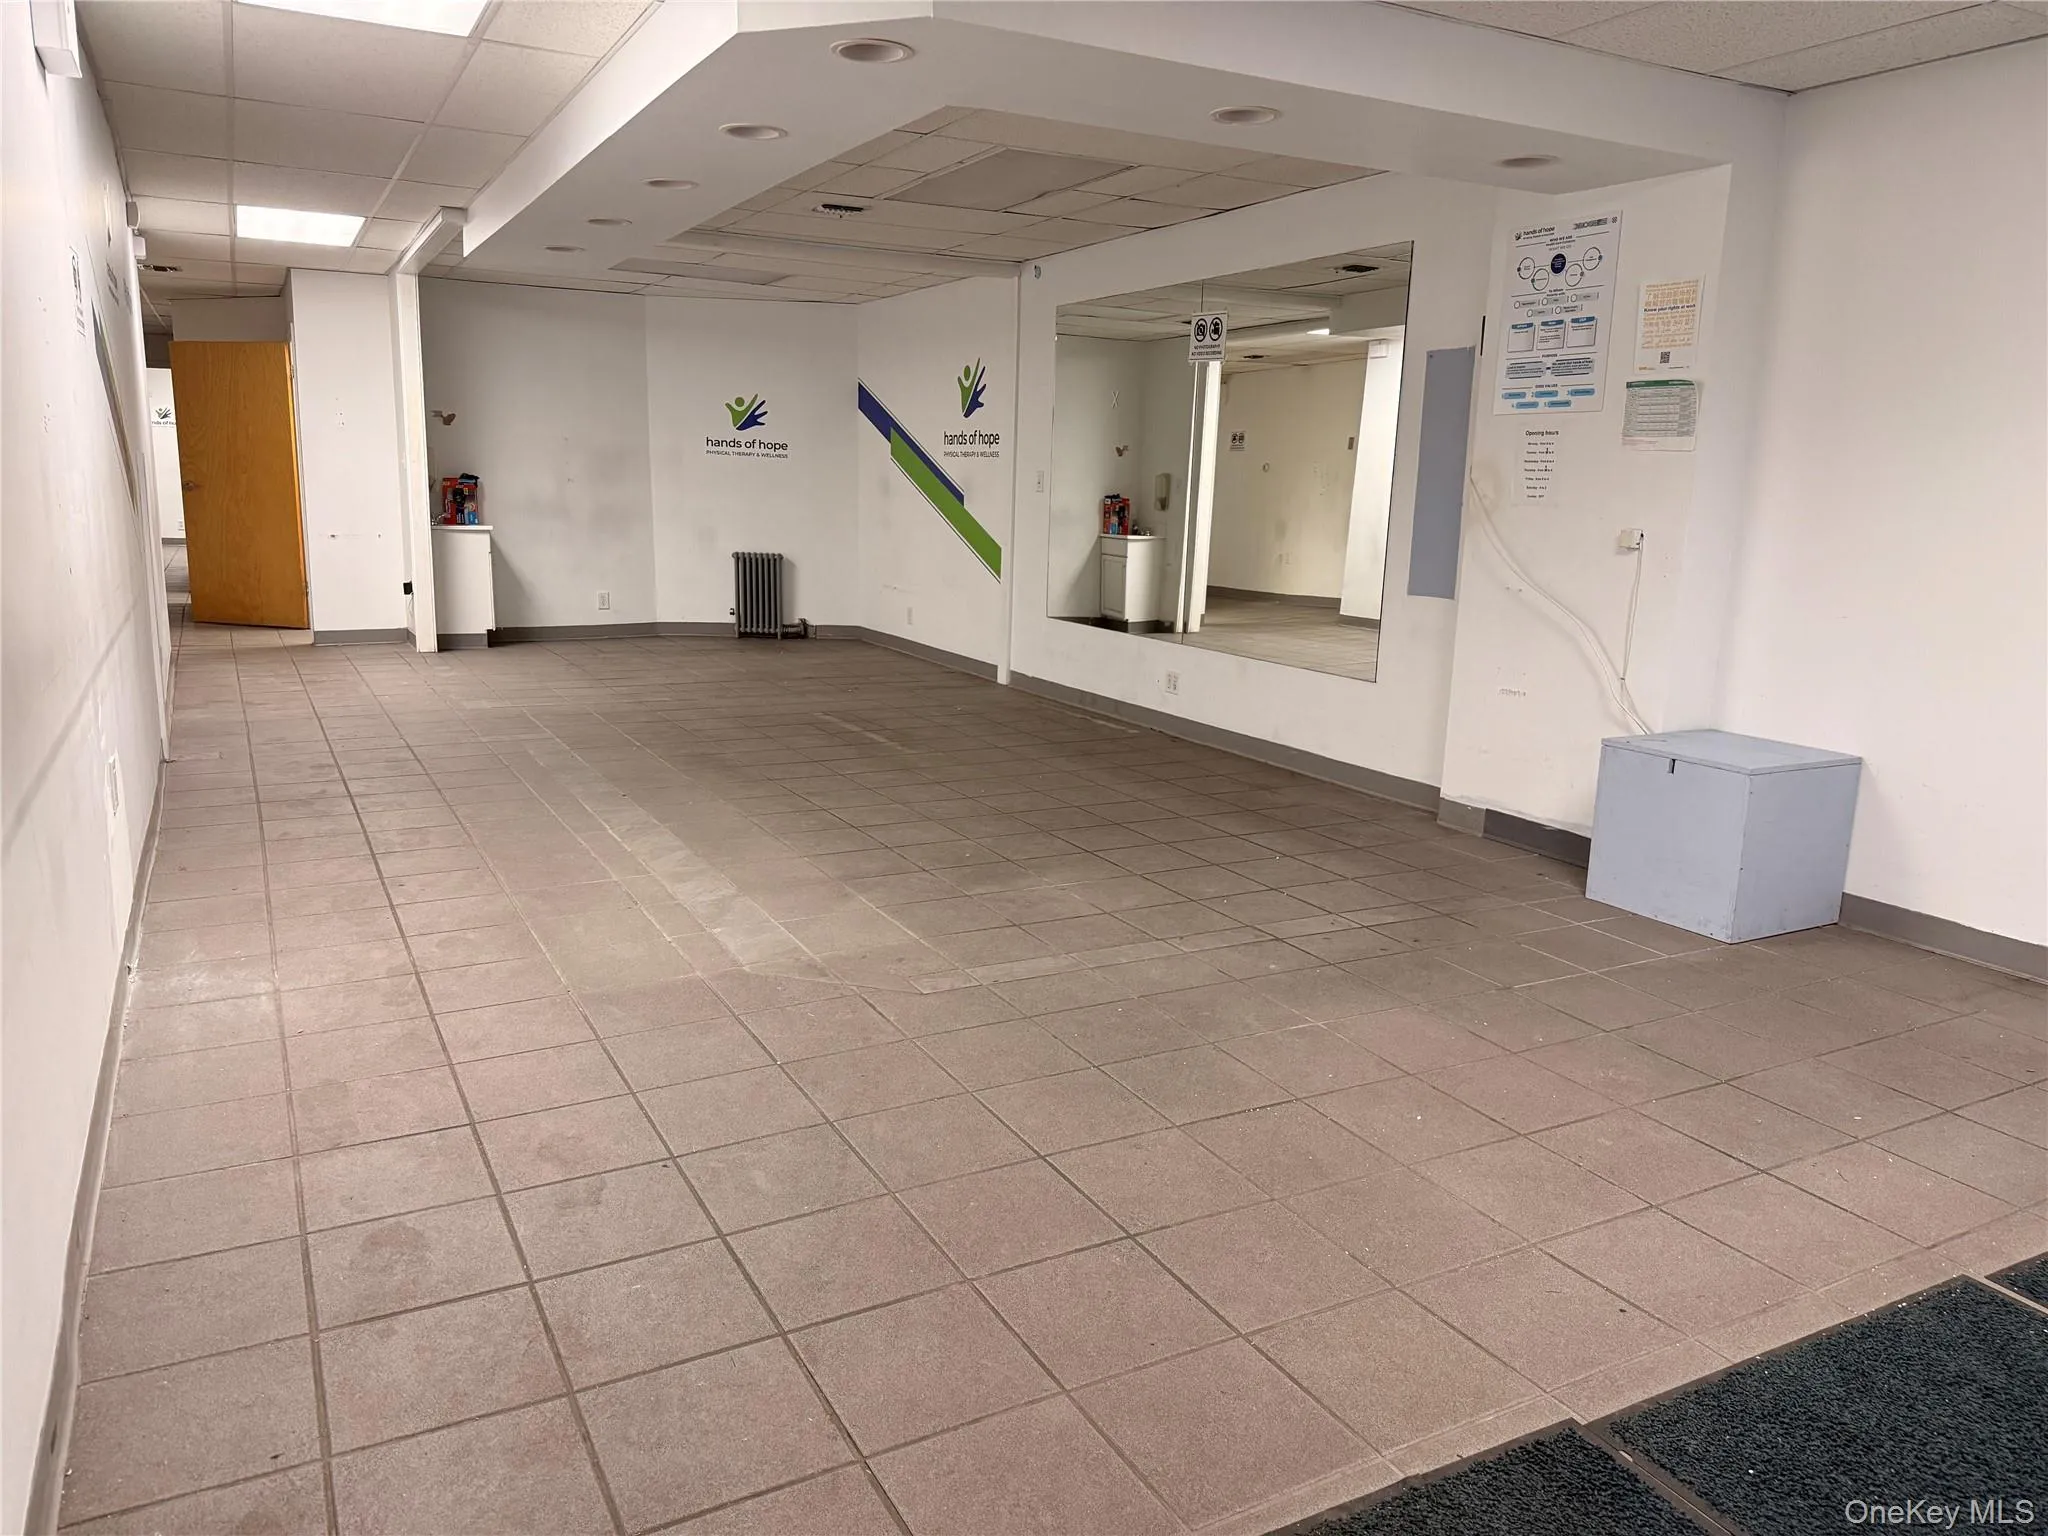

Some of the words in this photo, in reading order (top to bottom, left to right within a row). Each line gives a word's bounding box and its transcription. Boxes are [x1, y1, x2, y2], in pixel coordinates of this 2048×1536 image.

[706, 436, 742, 449] hands
[744, 438, 757, 449] of
[759, 439, 789, 453] hope
[944, 430, 967, 445] hands
[969, 430, 978, 445] of
[978, 430, 999, 448] hope
